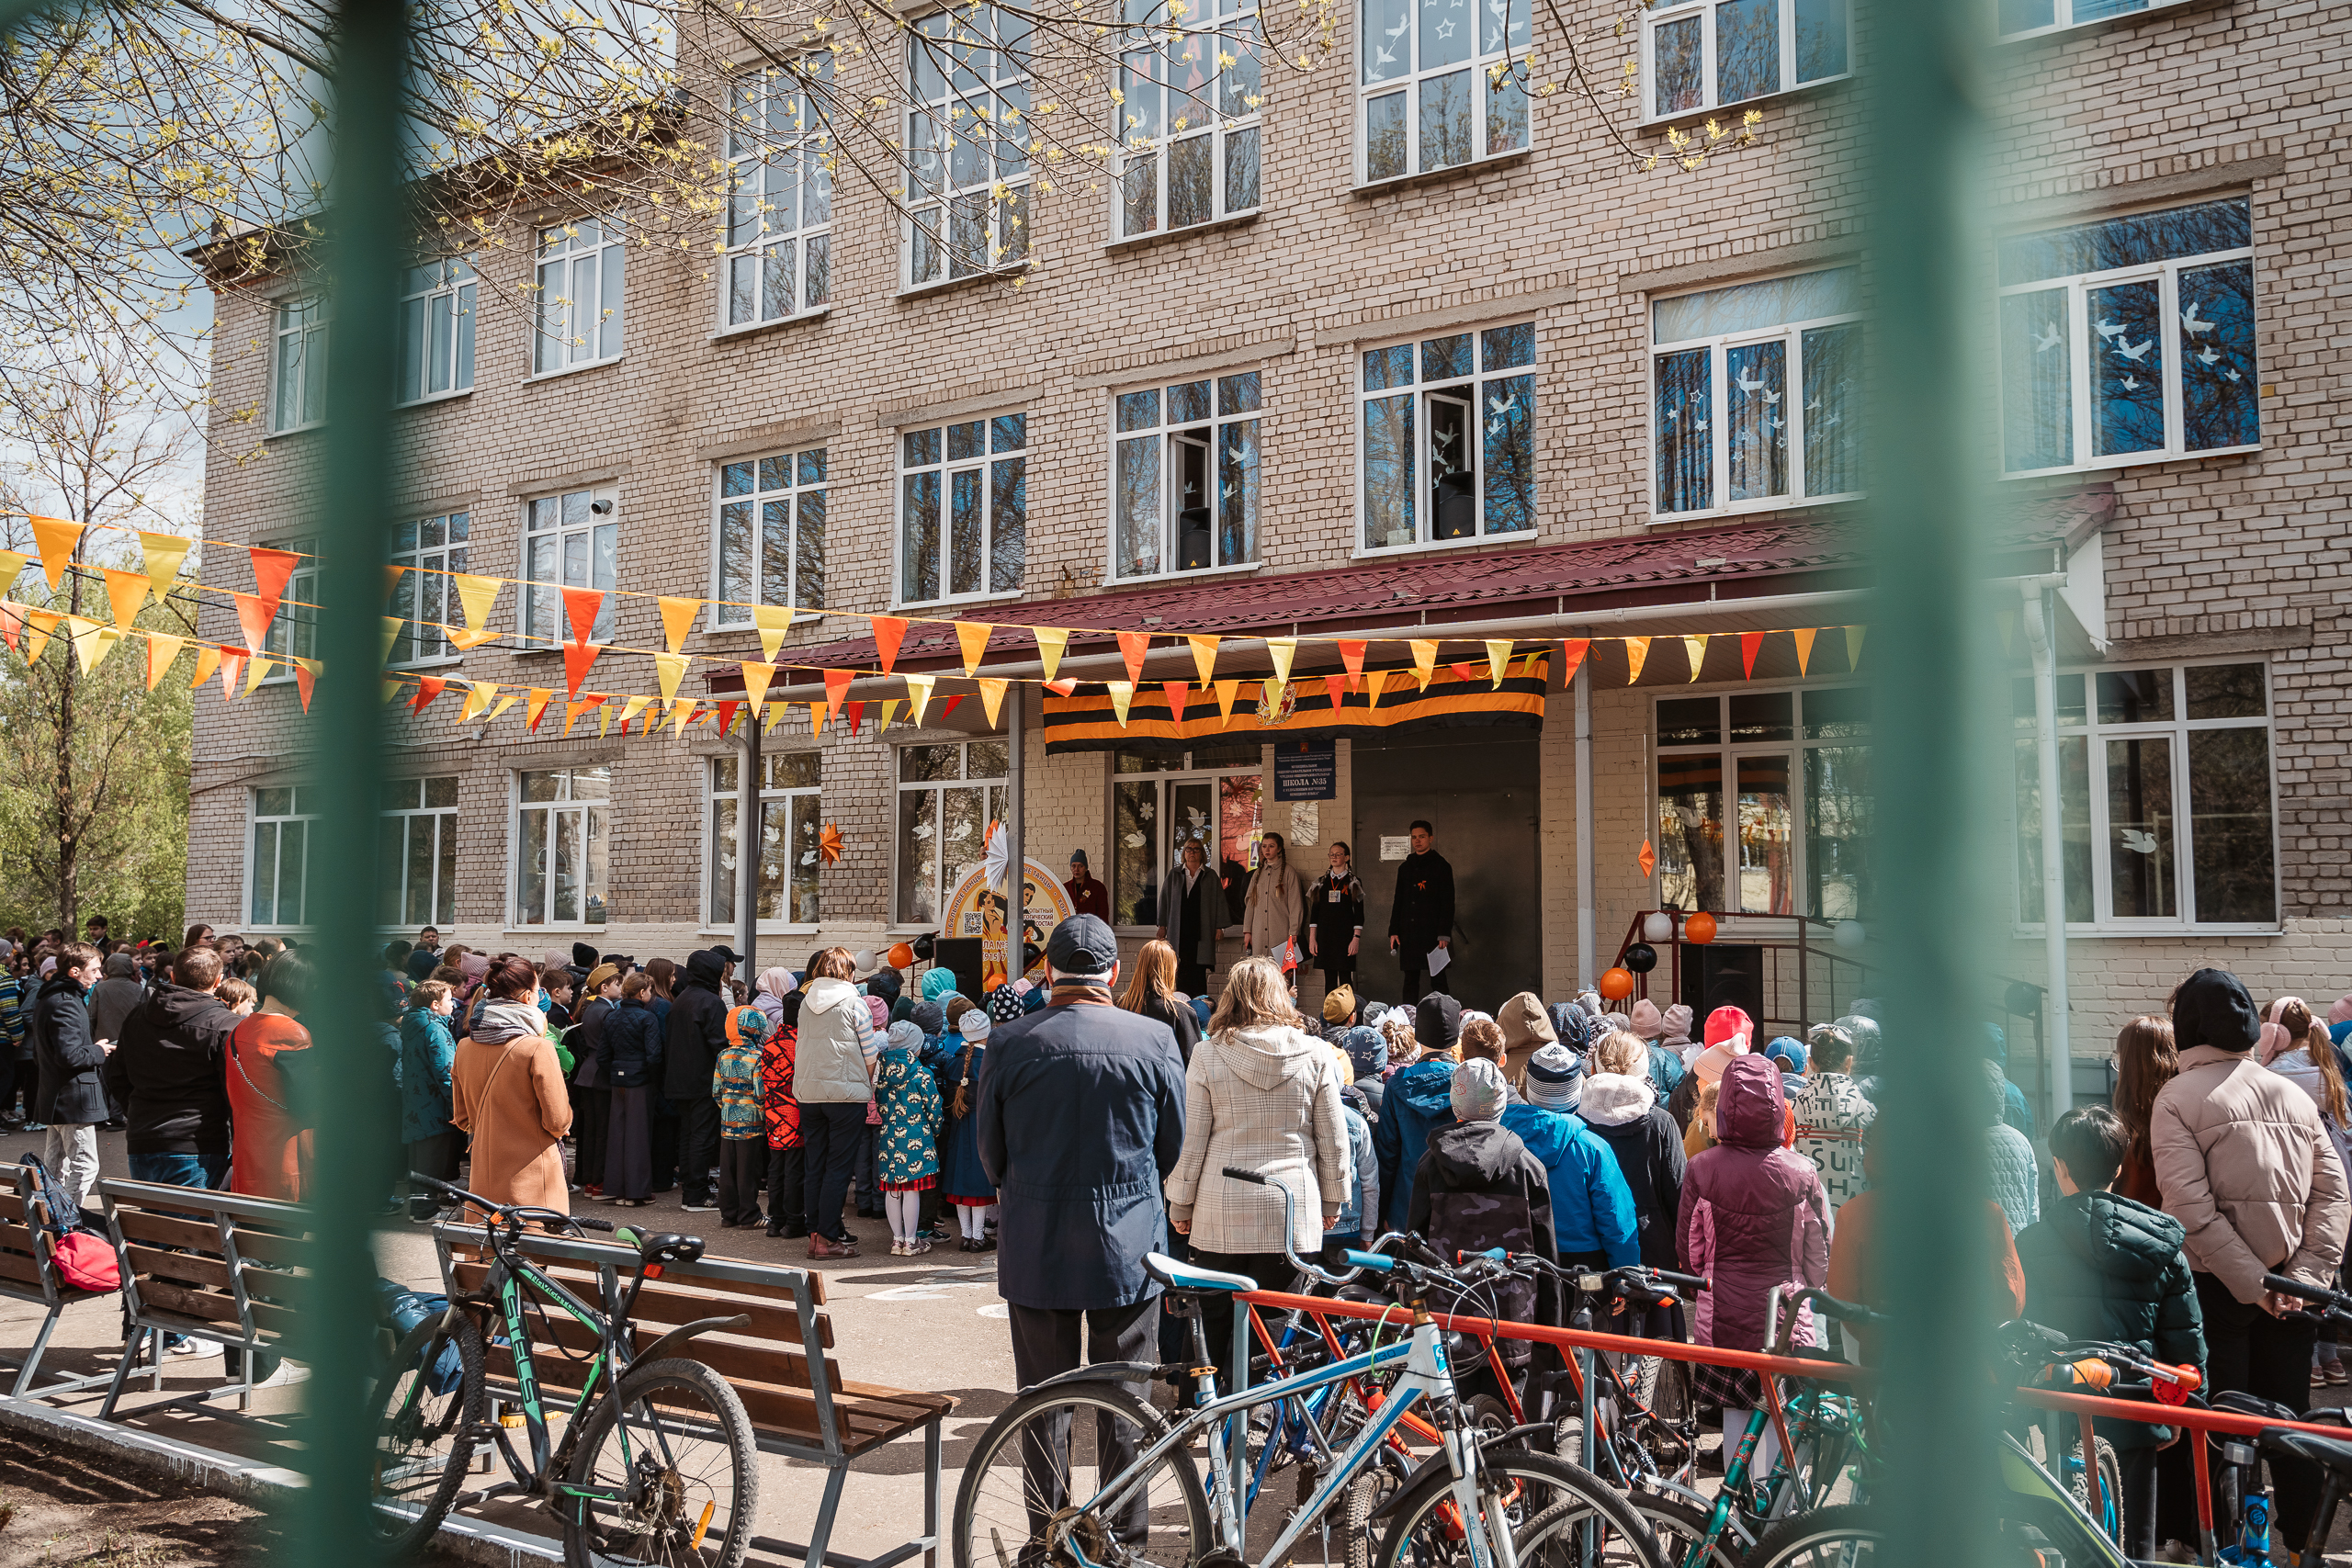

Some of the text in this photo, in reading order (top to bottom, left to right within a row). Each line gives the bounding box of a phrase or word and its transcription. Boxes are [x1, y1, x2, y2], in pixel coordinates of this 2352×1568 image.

[947, 892, 966, 929] БАЛЬНЫЕ
[962, 873, 983, 893] ТАНЦЫ
[1033, 870, 1054, 890] ТАНЦЫ
[1057, 897, 1069, 919] ХОРЕ
[982, 941, 995, 949] ЛА
[530, 1274, 581, 1315] NAVIGATOR
[505, 1294, 536, 1404] STELS
[1314, 1397, 1393, 1504] STELS
[1212, 1456, 1232, 1519] CROSS
